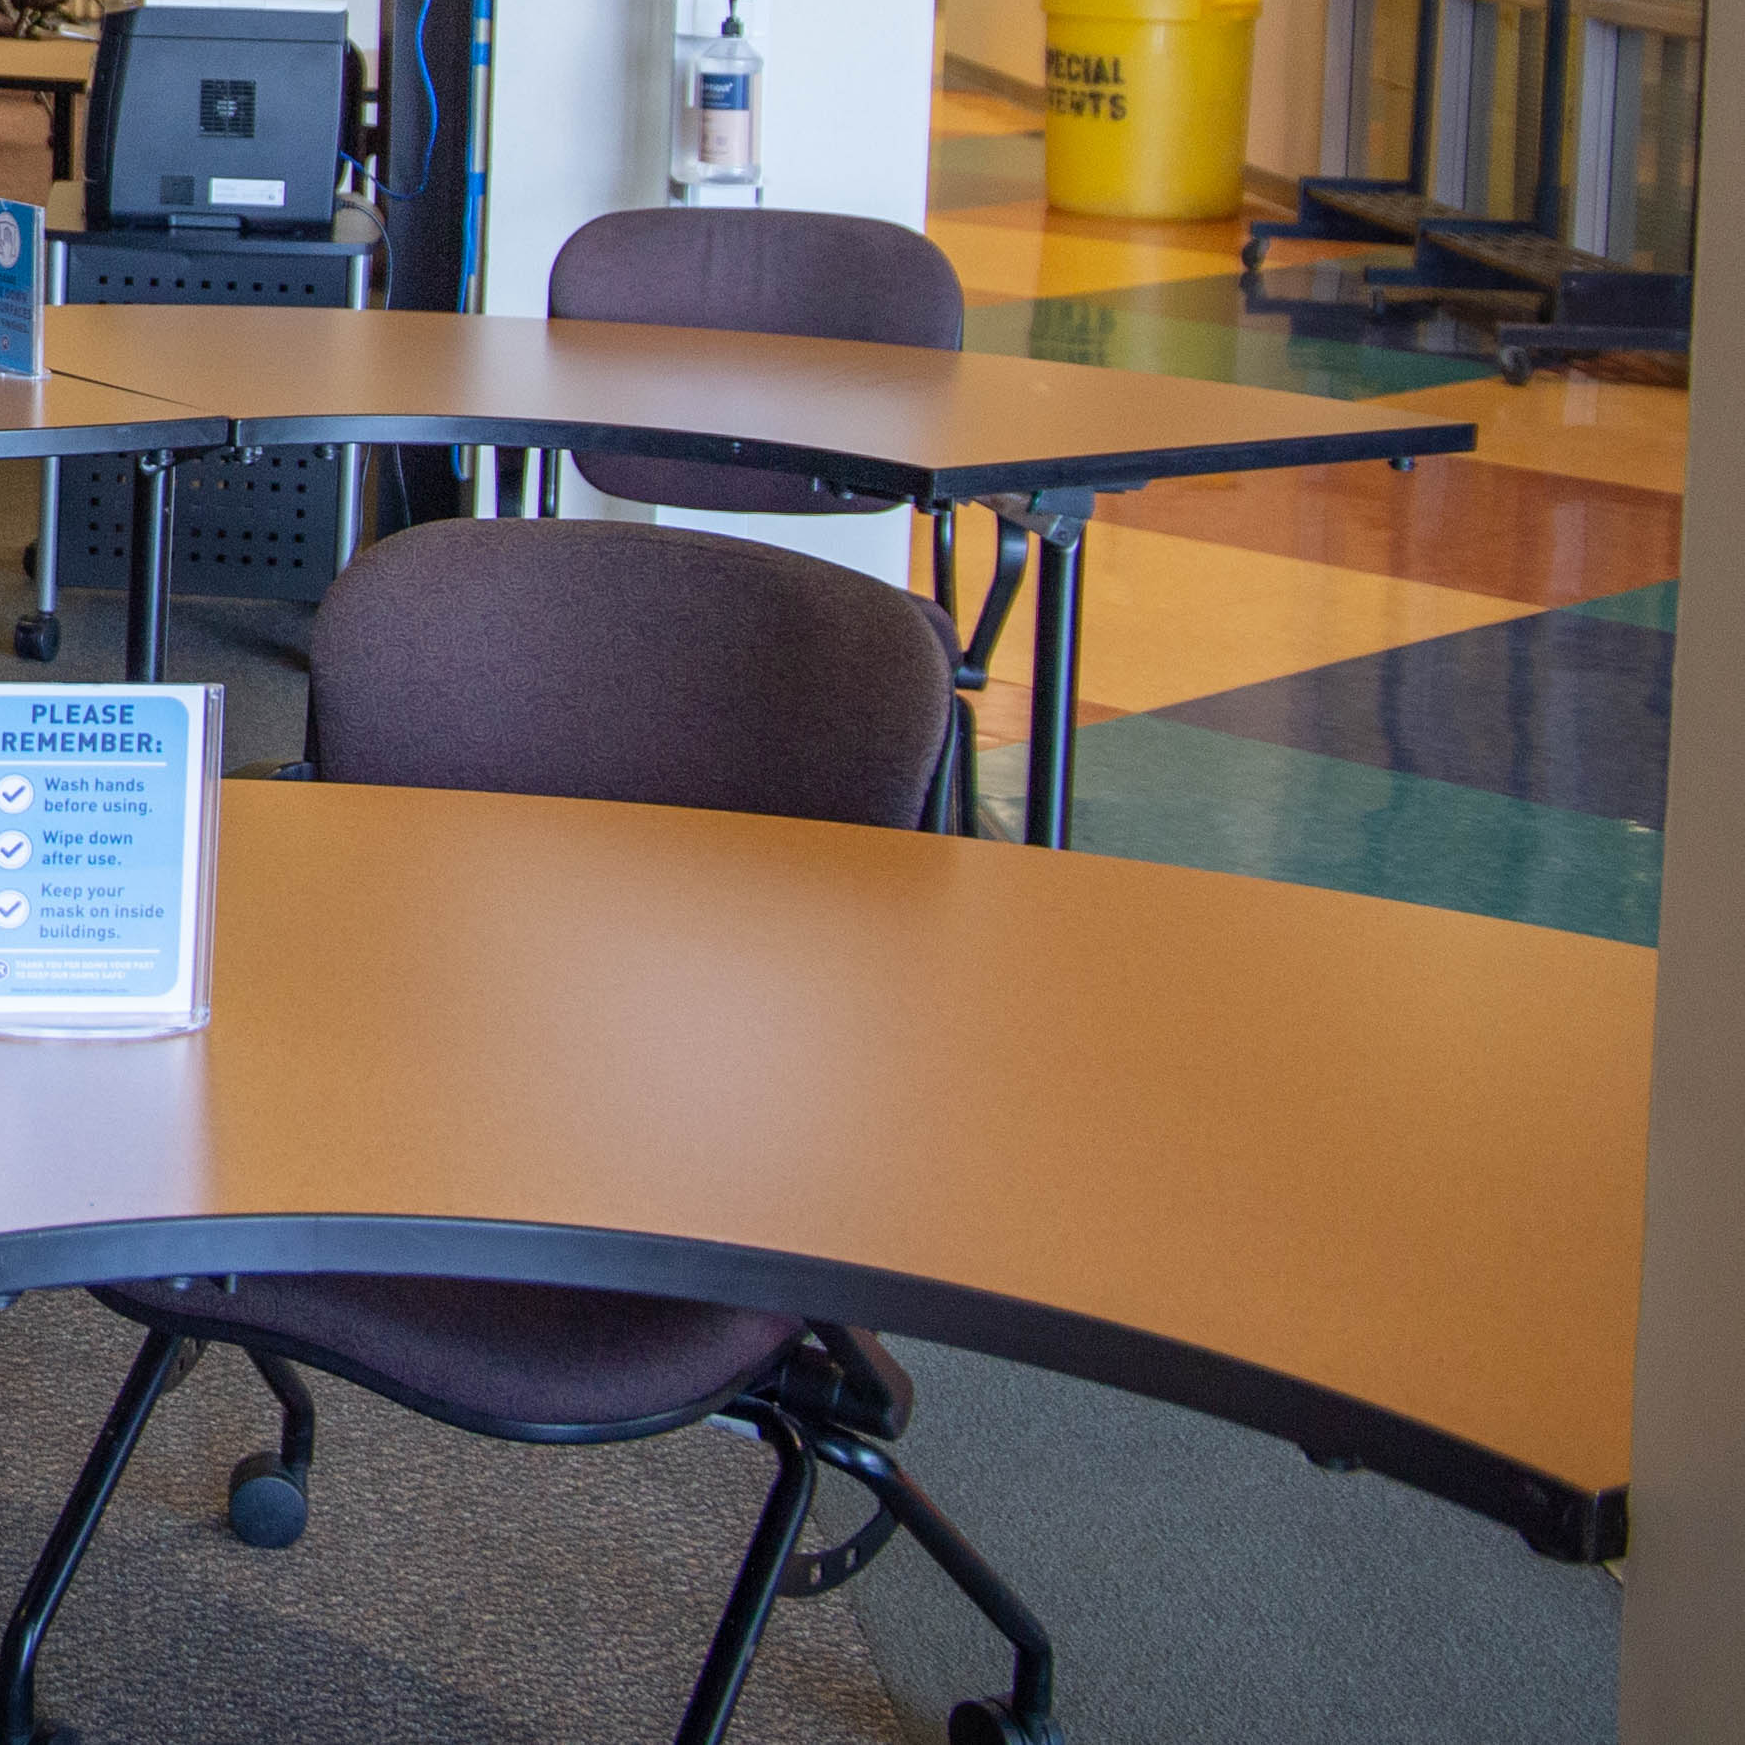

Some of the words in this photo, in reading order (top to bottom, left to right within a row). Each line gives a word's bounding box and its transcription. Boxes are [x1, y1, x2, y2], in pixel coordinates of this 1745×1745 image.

[1046, 48, 1125, 85] PECIAL
[1046, 86, 1127, 121] ENTS
[31, 704, 135, 725] PLEASE
[1, 732, 163, 753] REMEMBER:
[44, 777, 89, 792] Wash
[94, 777, 145, 792] hands
[44, 798, 98, 813] before
[102, 798, 153, 816] using.
[42, 830, 84, 848] Wipe
[89, 830, 133, 845] down
[41, 850, 82, 866] after
[87, 853, 122, 866] use.
[40, 882, 83, 900] Keep
[87, 886, 125, 901] your
[40, 904, 85, 918] mask
[89, 907, 110, 918] on
[114, 904, 165, 918] inside
[39, 924, 121, 942] buildings.
